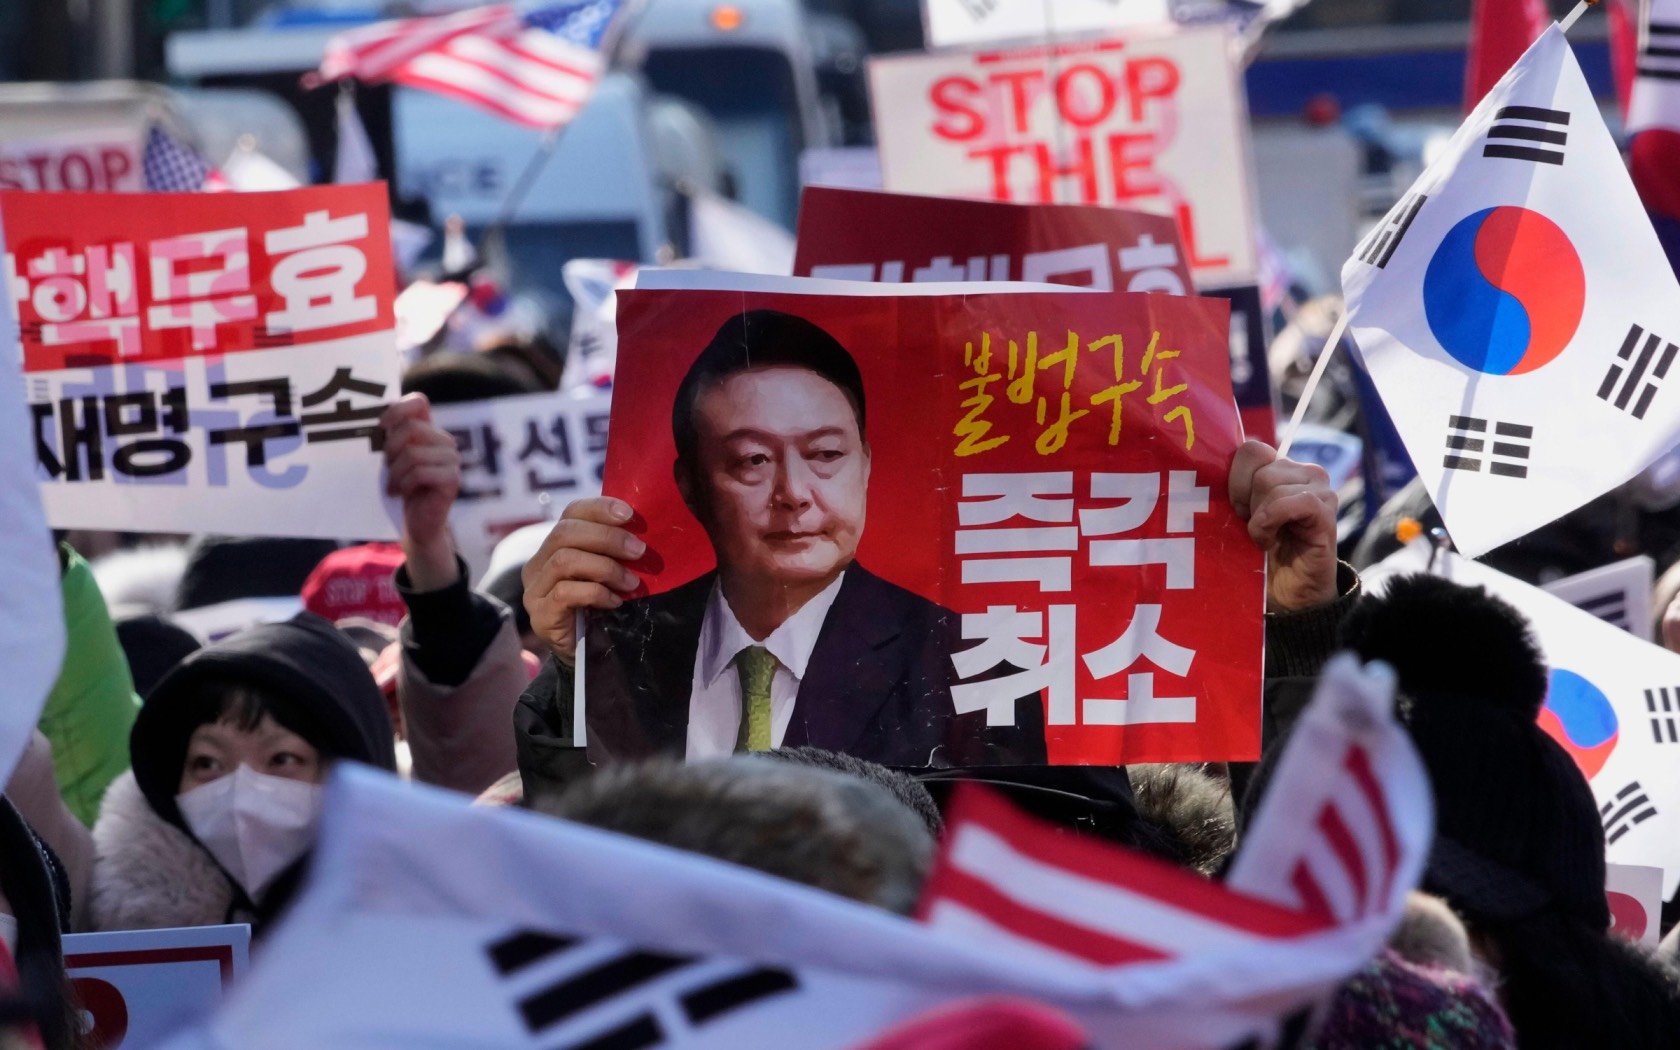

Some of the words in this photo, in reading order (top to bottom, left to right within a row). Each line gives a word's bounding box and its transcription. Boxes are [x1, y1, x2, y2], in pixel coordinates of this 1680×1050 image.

[929, 57, 1181, 142] STOP
[967, 132, 1163, 206] THE
[5, 210, 378, 358] 핵무효
[31, 385, 192, 482] 재명
[209, 367, 390, 468] 구속
[953, 329, 1195, 457] 불법구속
[447, 424, 503, 500] 란
[954, 470, 1210, 592] 즉각
[950, 604, 1197, 727] 취소
